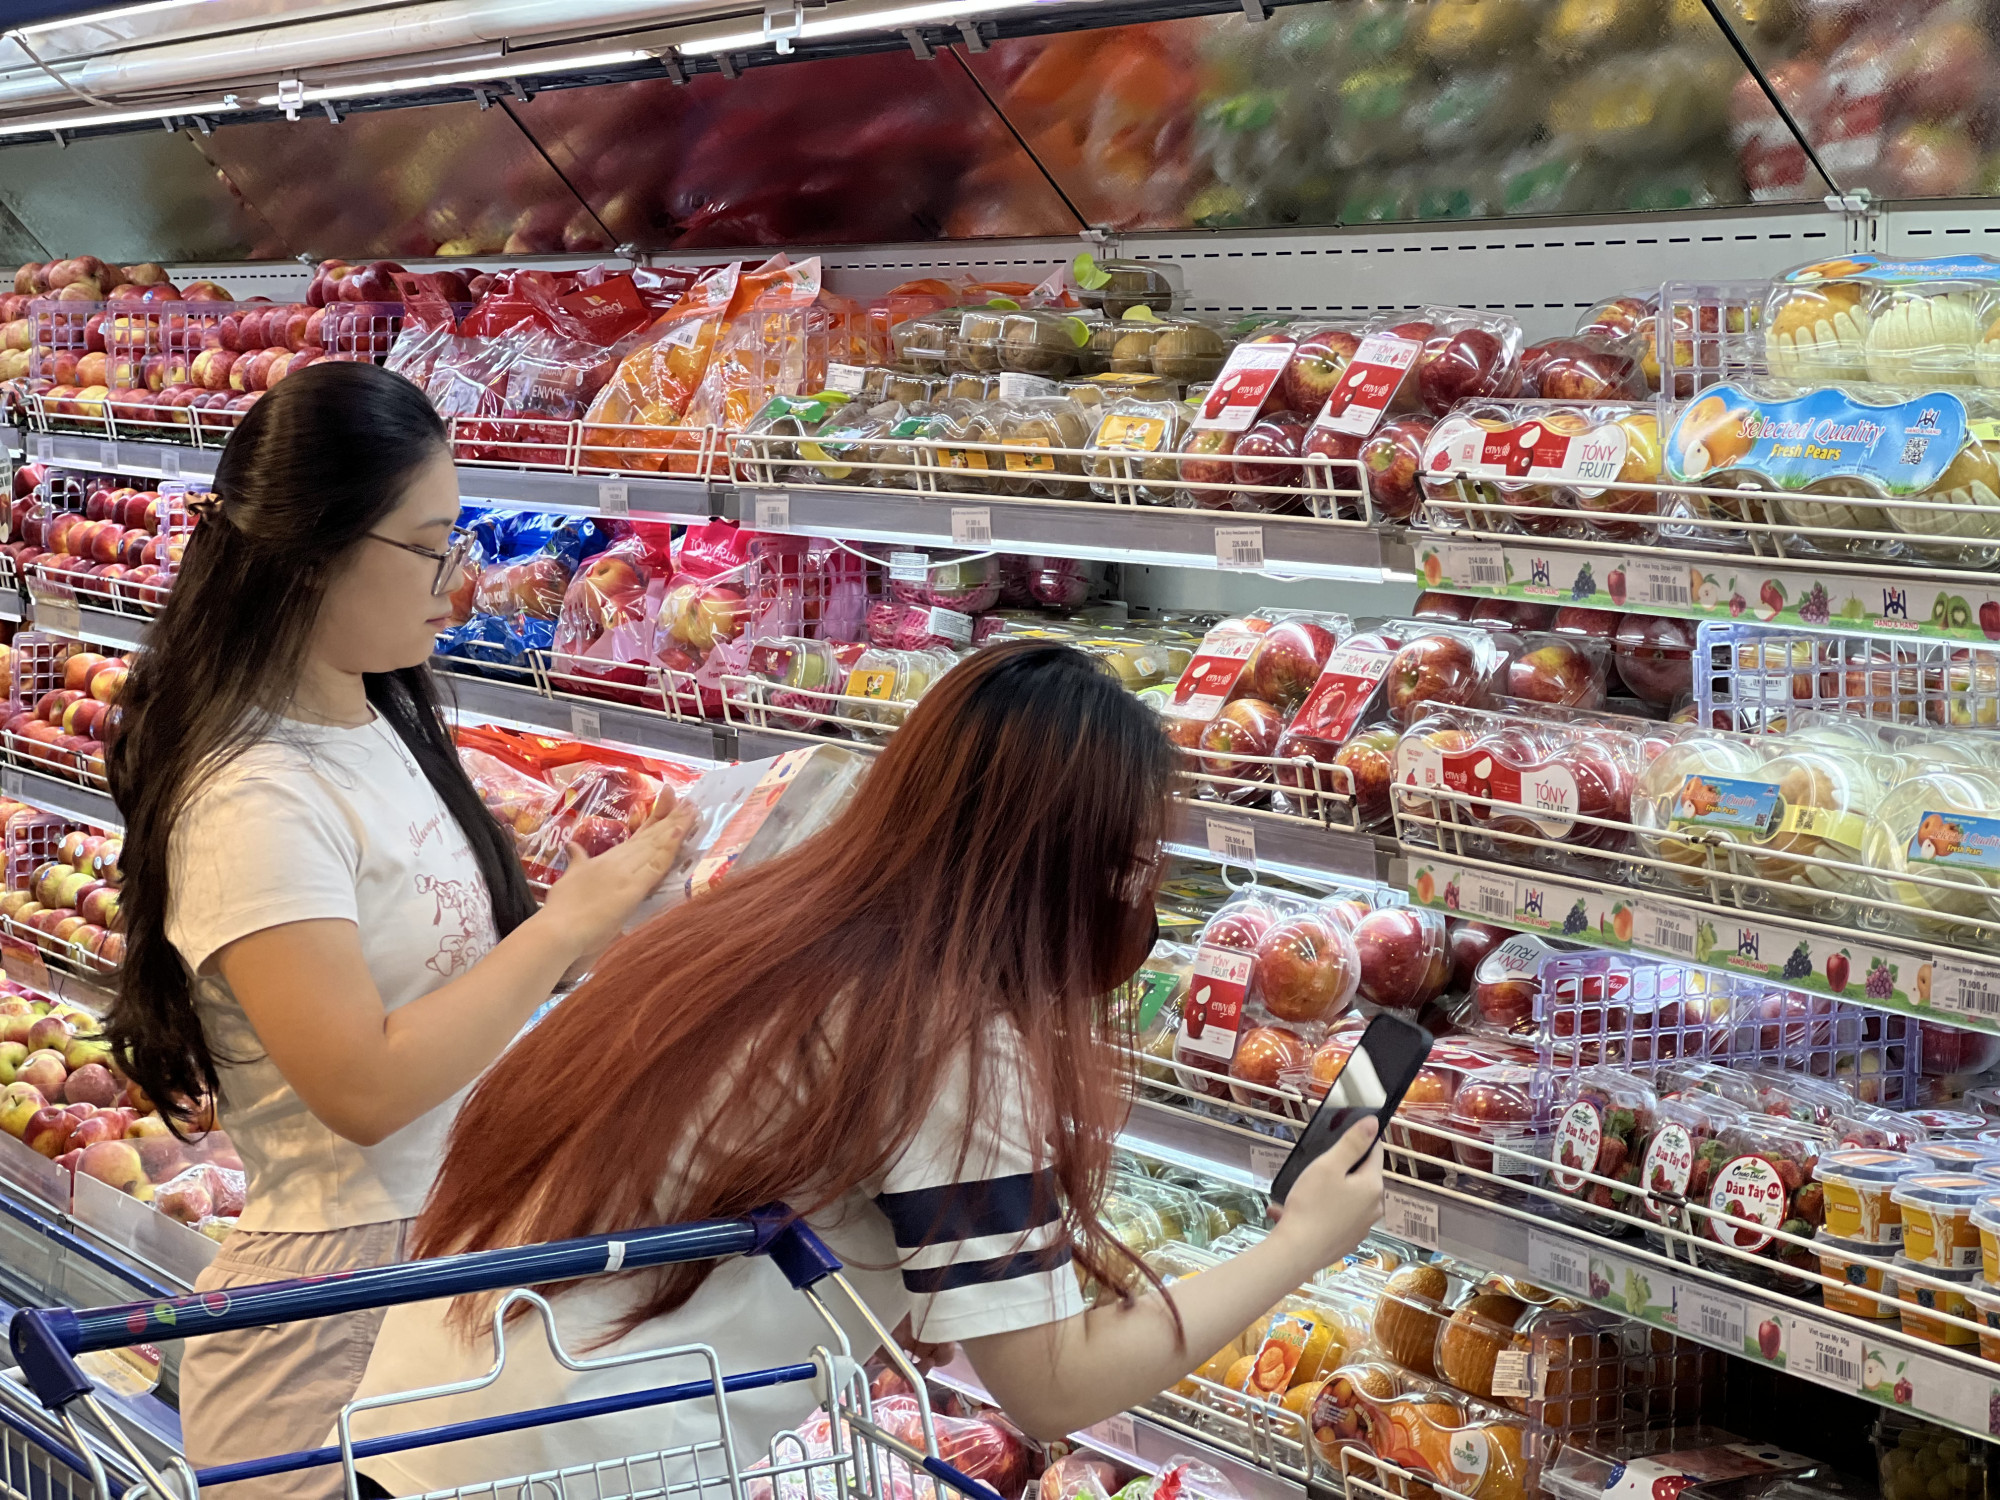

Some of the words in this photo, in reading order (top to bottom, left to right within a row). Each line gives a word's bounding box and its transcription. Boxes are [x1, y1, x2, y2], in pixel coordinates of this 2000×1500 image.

[1736, 416, 1816, 441] Selected
[1814, 418, 1887, 448] Quality
[1582, 440, 1618, 461] TÓNY
[1770, 443, 1802, 458] Fresh
[1803, 444, 1842, 461] Pears
[1577, 461, 1616, 478] FRUIT
[1874, 619, 1892, 627] HAND
[1900, 620, 1919, 630] HAND
[1534, 779, 1568, 804] TÓNY
[1725, 793, 1758, 808] Quality
[1706, 804, 1722, 813] Fresh
[1722, 806, 1739, 815] Pears
[1947, 844, 1964, 853] Fresh
[1966, 846, 1983, 856] Pears
[1727, 956, 1745, 967] HAND
[1751, 960, 1769, 972] HAND
[1211, 1001, 1228, 1018] envy
[1767, 1186, 1780, 1196] AN
[1831, 1334, 1839, 1343] My
[1816, 1341, 1837, 1356] 72.600
